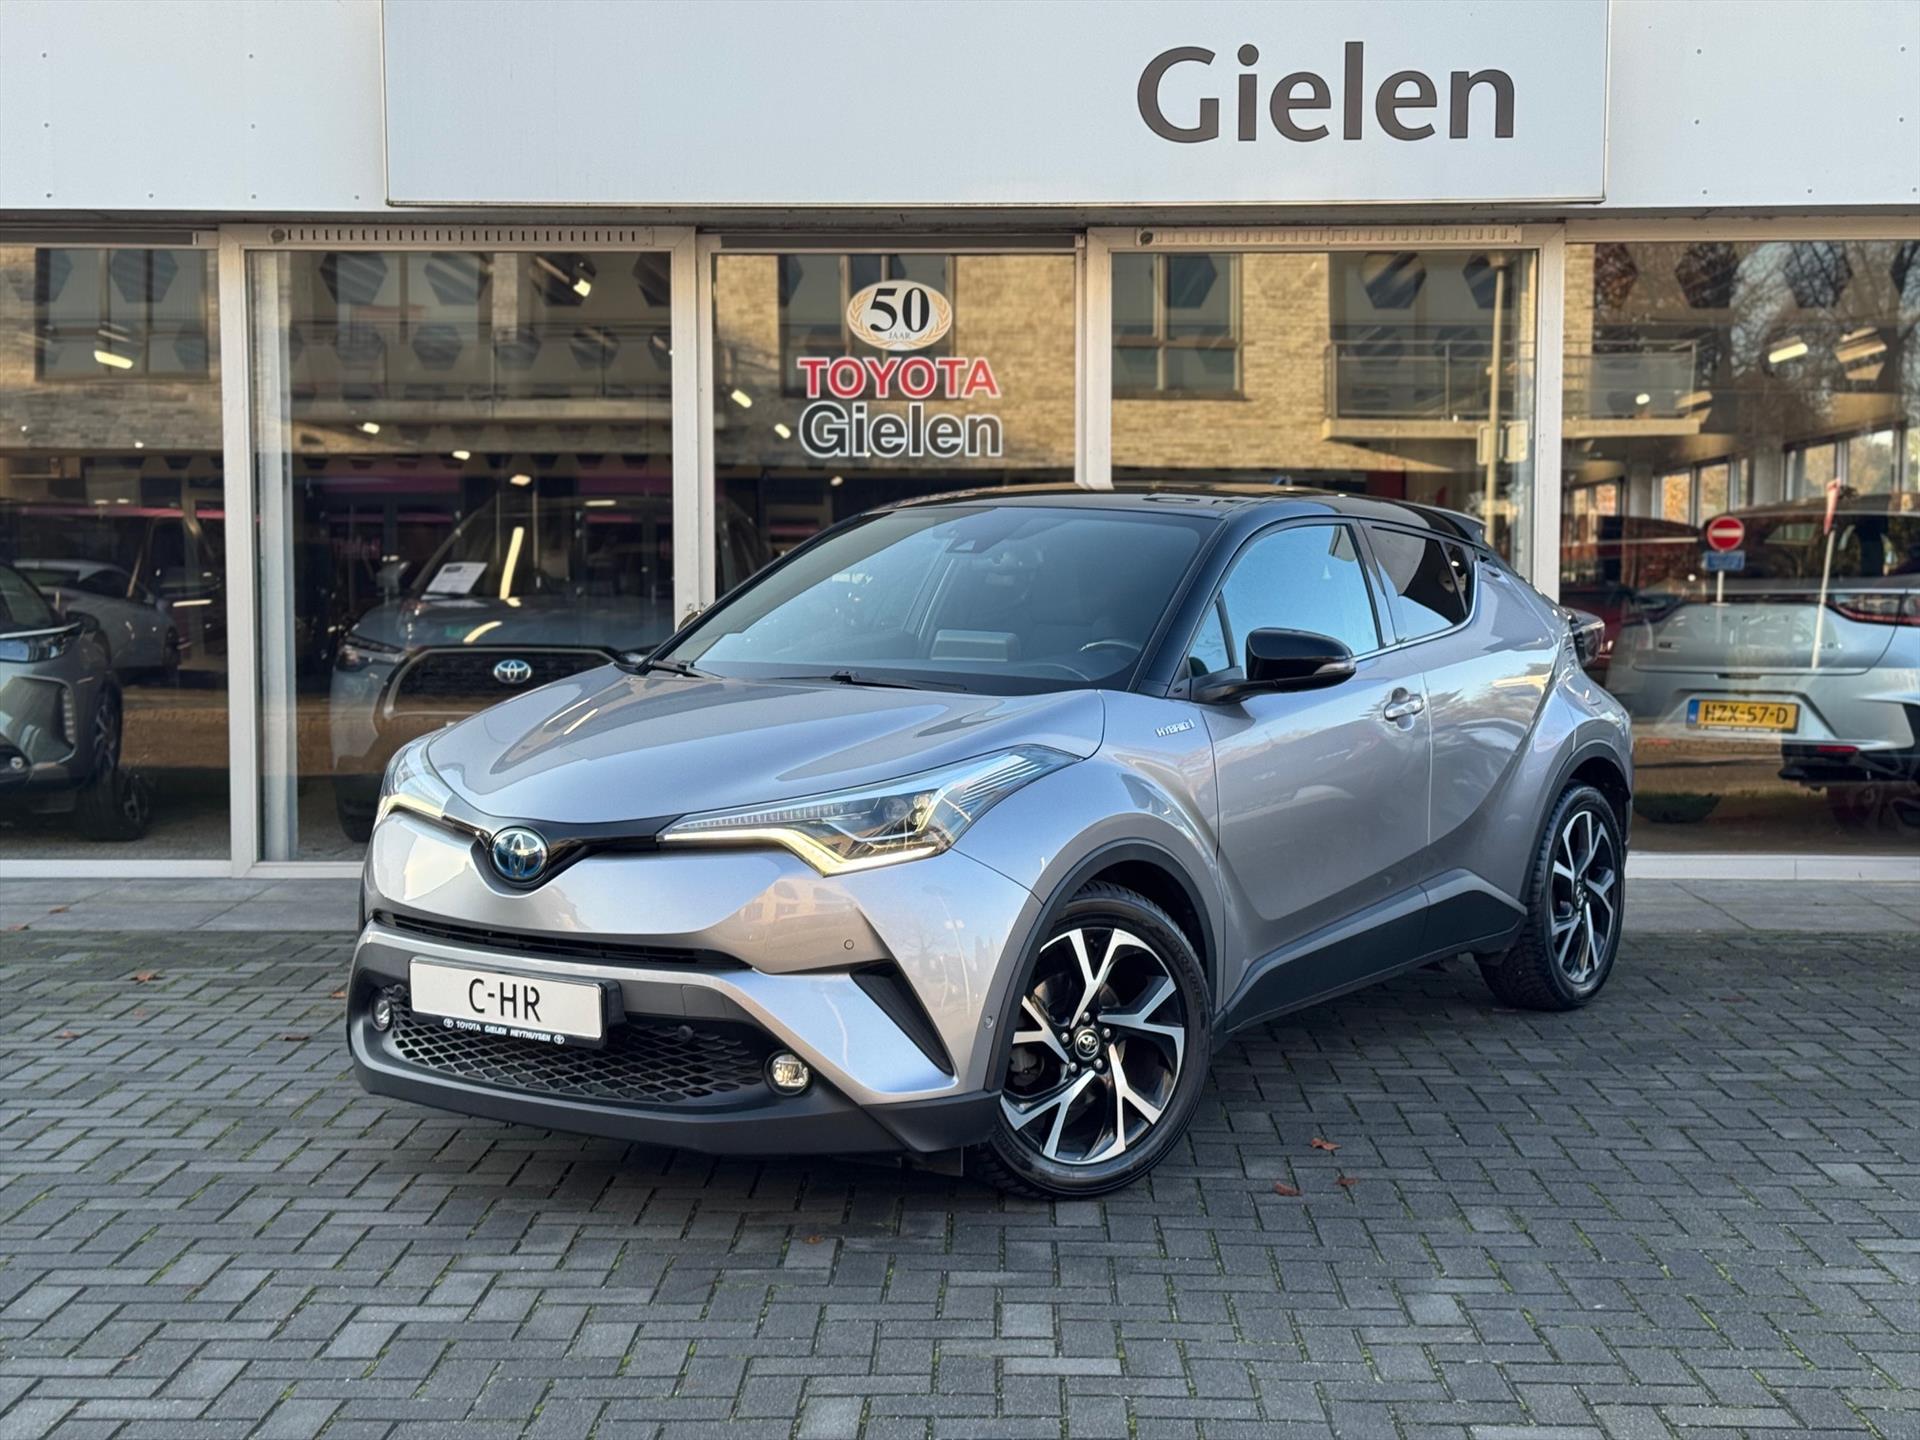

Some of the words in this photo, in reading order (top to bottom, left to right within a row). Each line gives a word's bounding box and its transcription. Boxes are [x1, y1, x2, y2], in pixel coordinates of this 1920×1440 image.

[1137, 41, 1516, 144] Gielen
[869, 287, 931, 333] 50
[797, 356, 1001, 399] TOYOTA
[800, 401, 1003, 458] Gielen
[1703, 703, 1788, 725] HZX-57-D
[468, 978, 541, 1022] C-HR
[456, 1020, 481, 1032] TOYOTA
[484, 1025, 507, 1036] GIELEN
